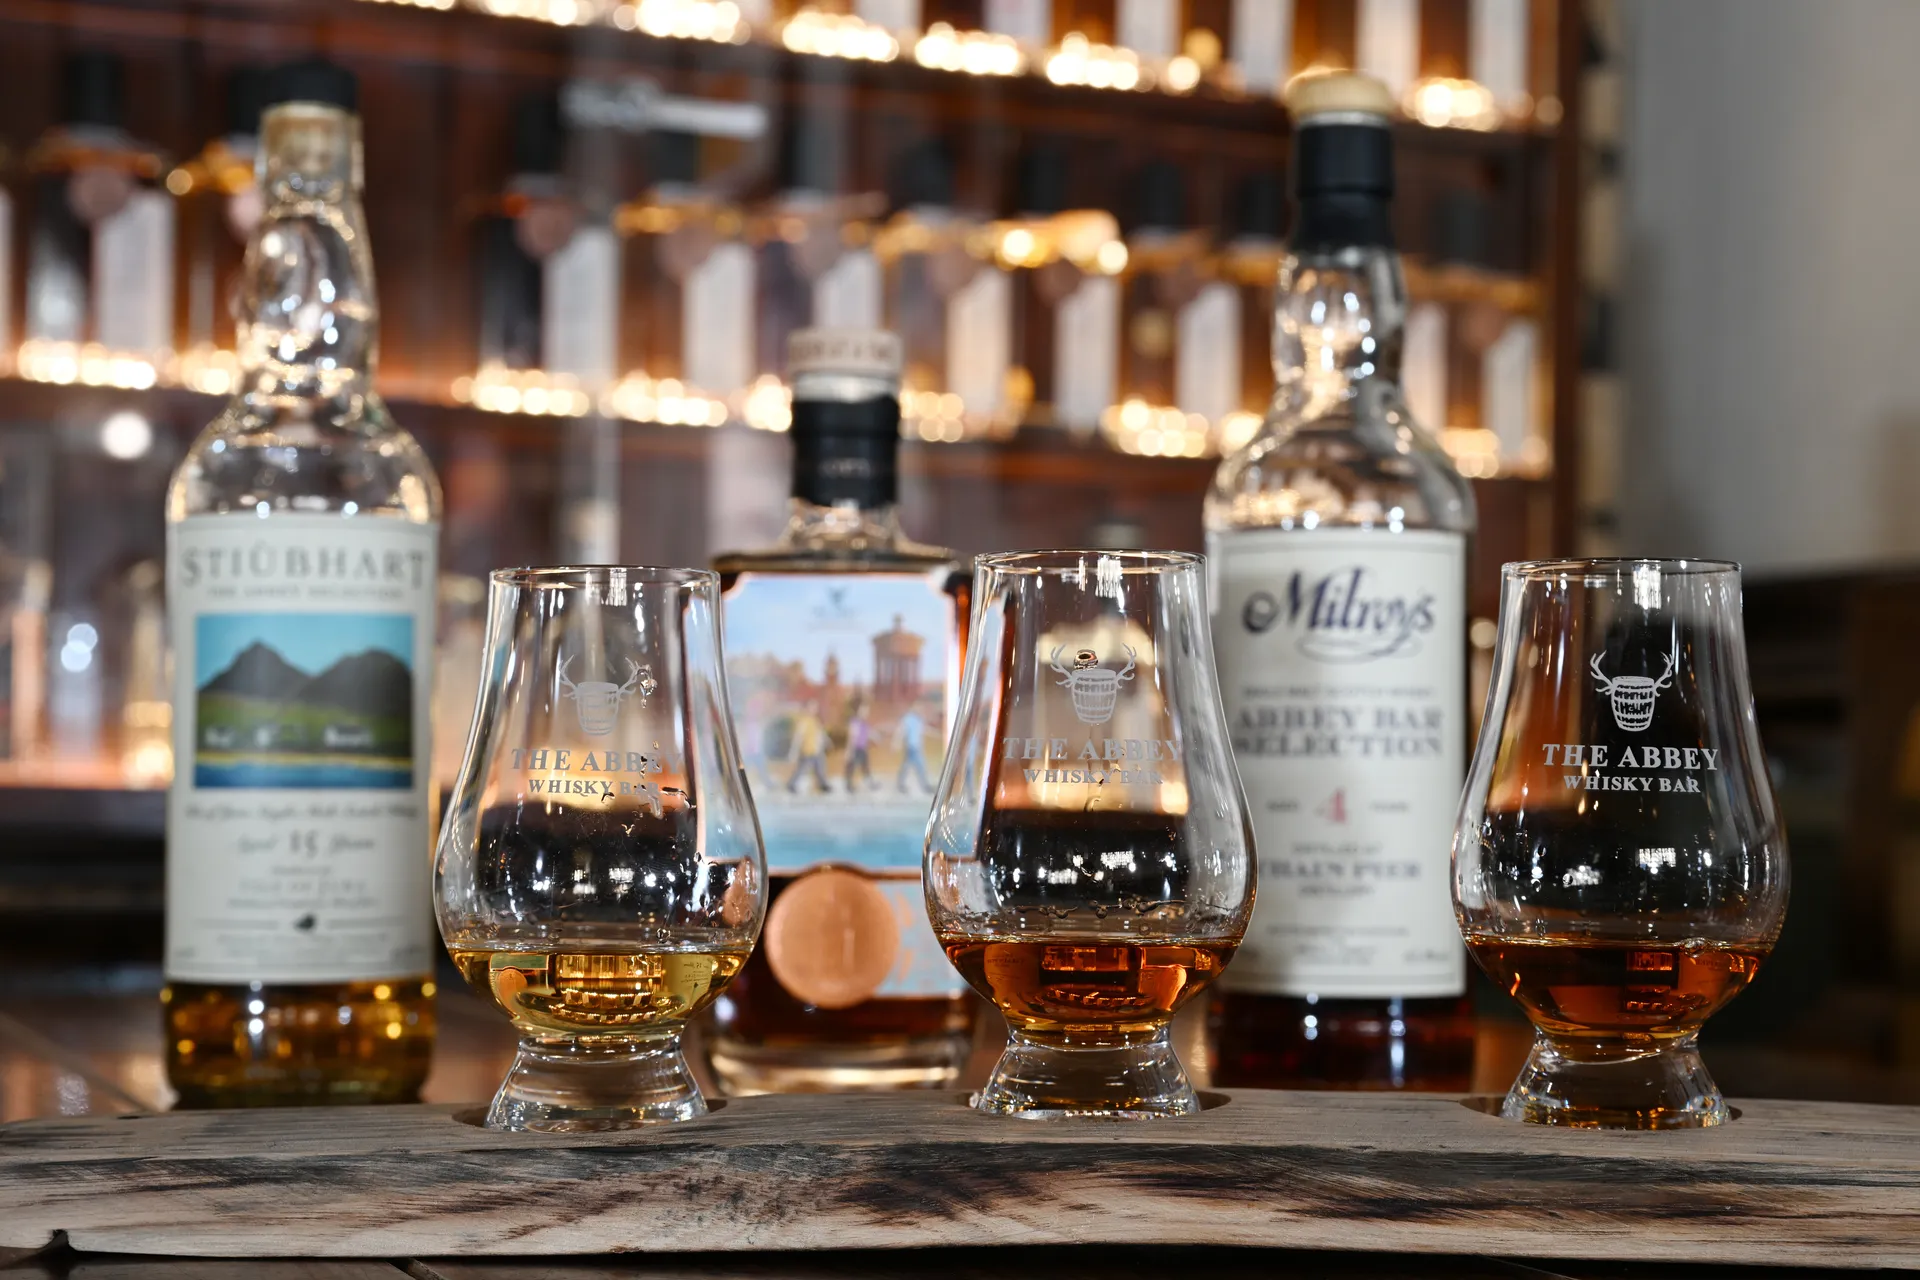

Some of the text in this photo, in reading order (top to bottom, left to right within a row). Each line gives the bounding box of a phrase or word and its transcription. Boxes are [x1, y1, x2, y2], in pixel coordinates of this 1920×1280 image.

[1003, 738, 1182, 761] THE ABBEY
[1542, 744, 1719, 770] THE ABBEY
[511, 749, 683, 774] THE ABBEY
[1023, 769, 1163, 784] WHISKY BAR
[1563, 775, 1701, 793] WHISKY BAR
[528, 779, 661, 796] WHISKY BAR
